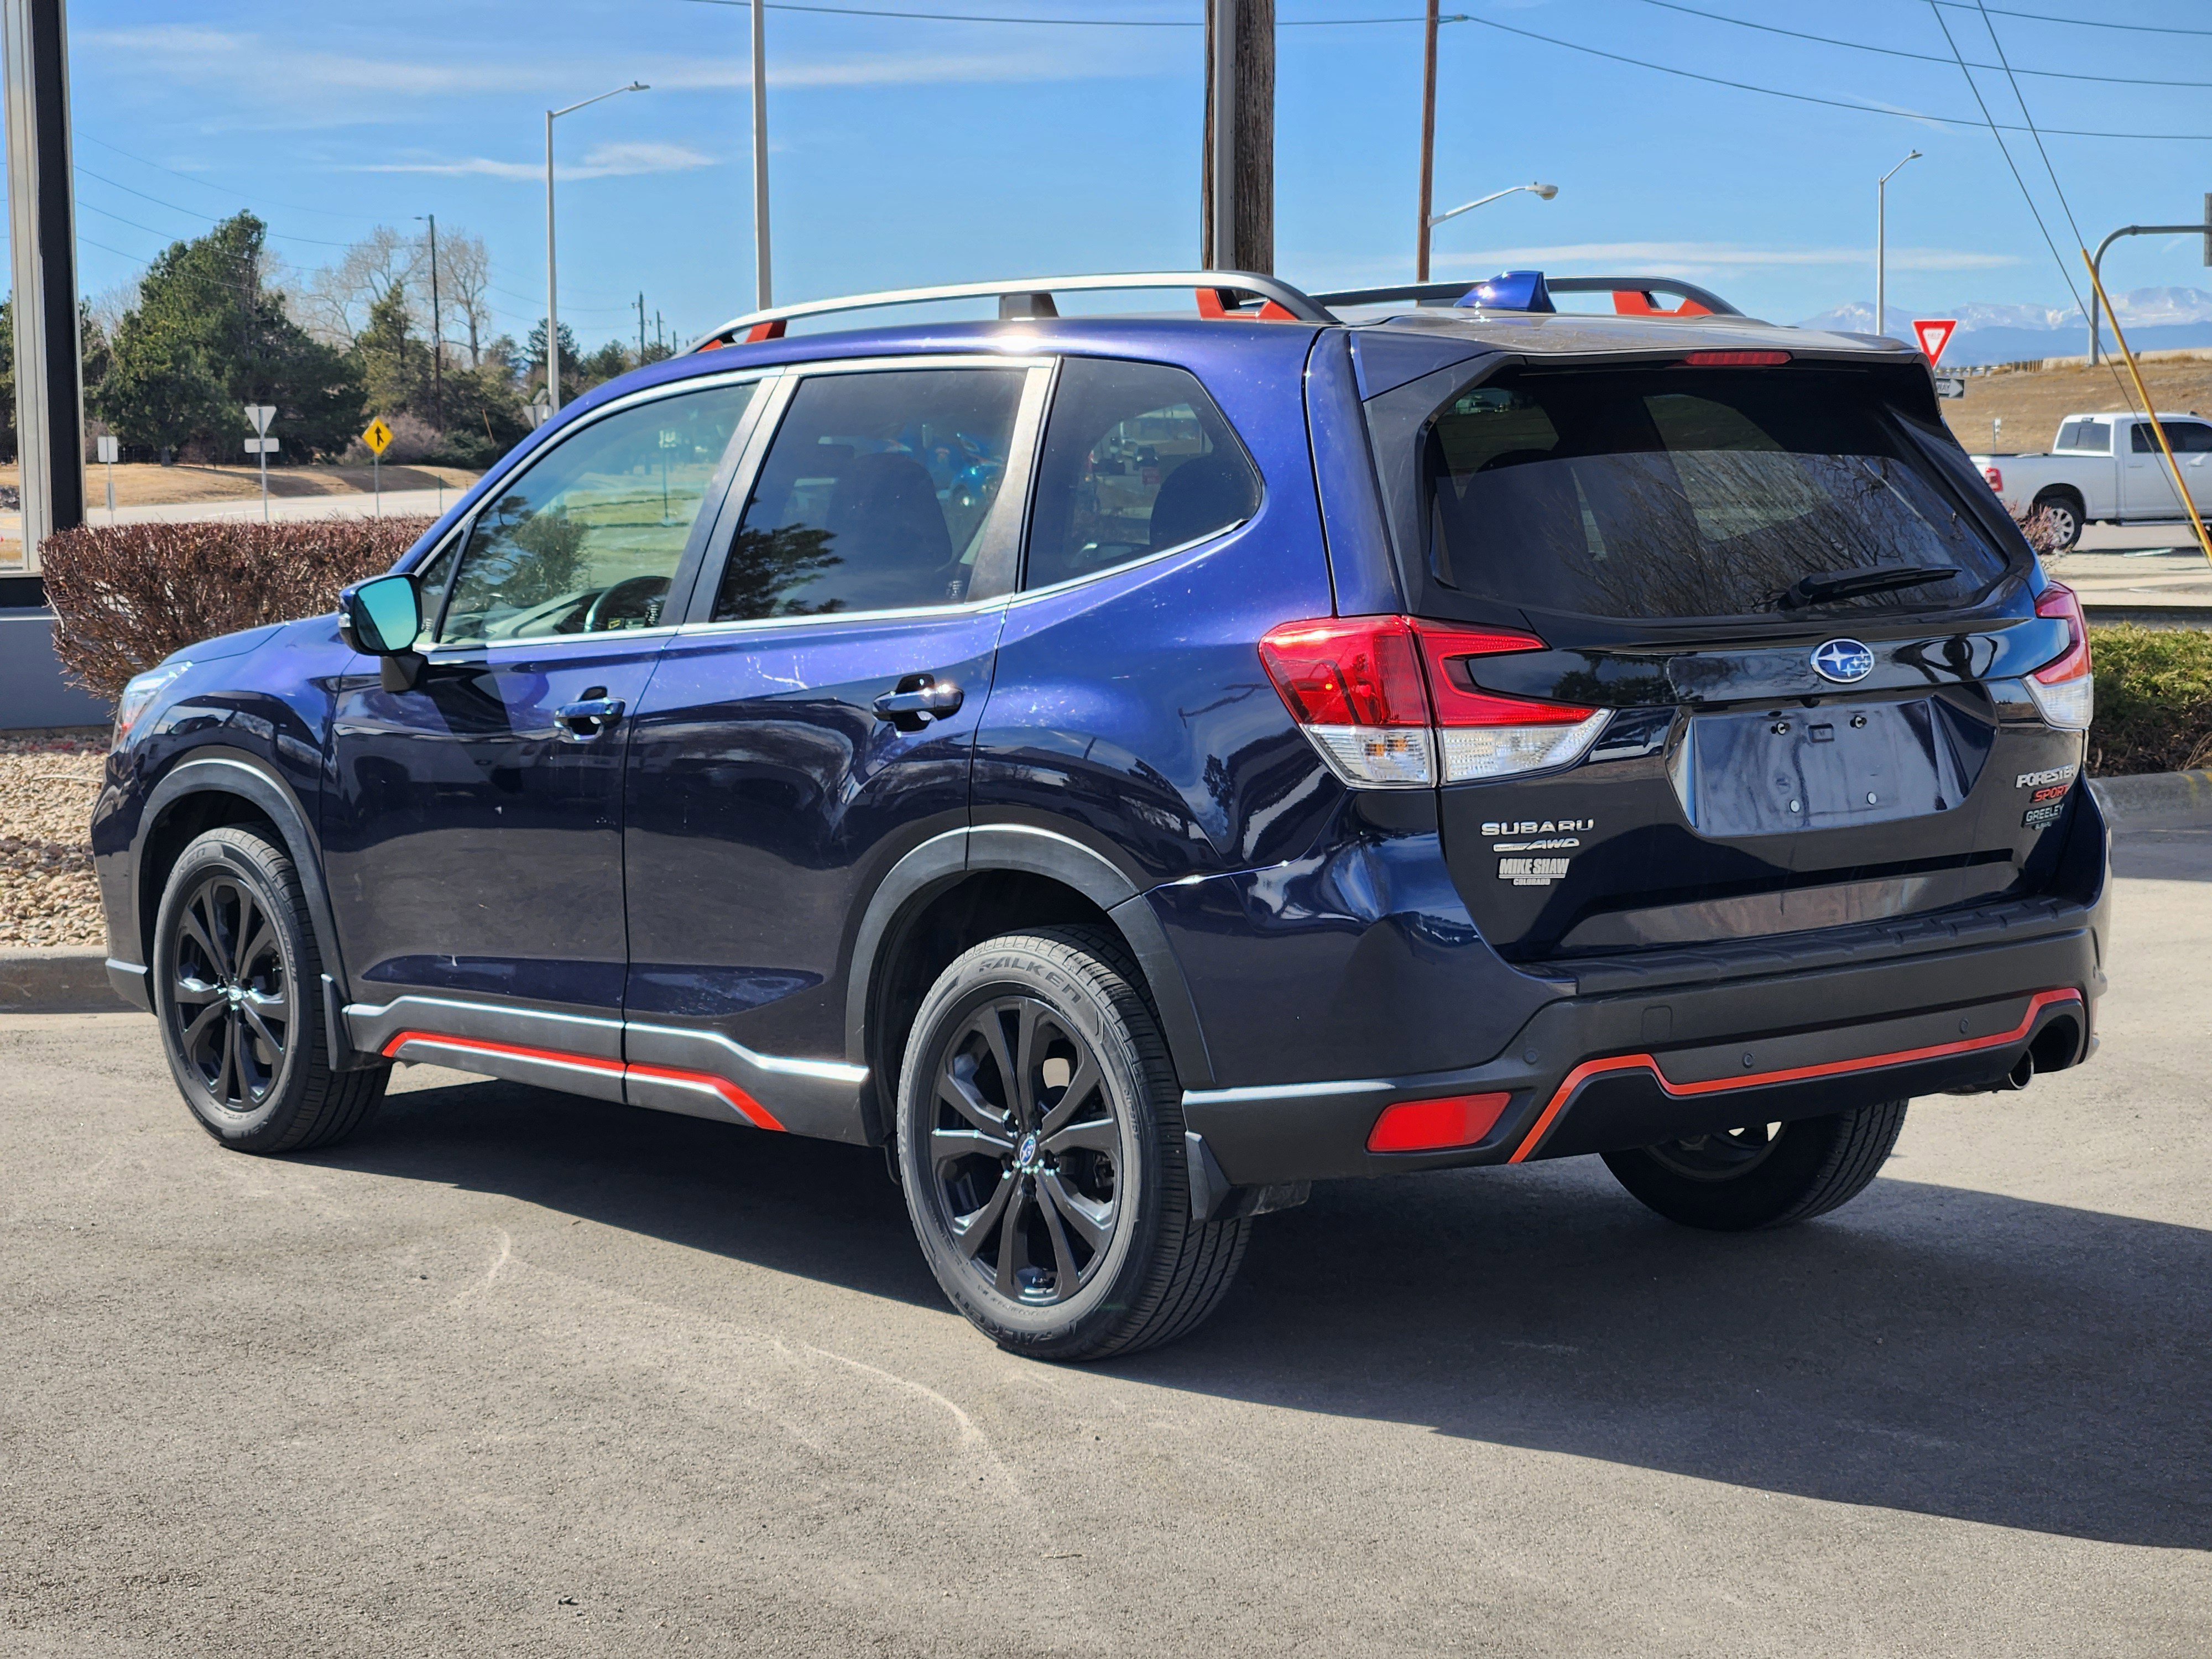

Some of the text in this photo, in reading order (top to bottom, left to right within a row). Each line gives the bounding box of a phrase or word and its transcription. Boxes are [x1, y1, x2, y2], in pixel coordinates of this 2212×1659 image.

[2016, 764, 2075, 788] FORESTER
[2034, 784, 2070, 802] SPORT
[2026, 804, 2064, 822] GREELEY
[1481, 818, 1594, 836] SUBARU
[1526, 838, 1579, 850] AWD
[1499, 858, 1570, 874] MIKE SHAW
[979, 956, 1082, 1004] FALKEN
